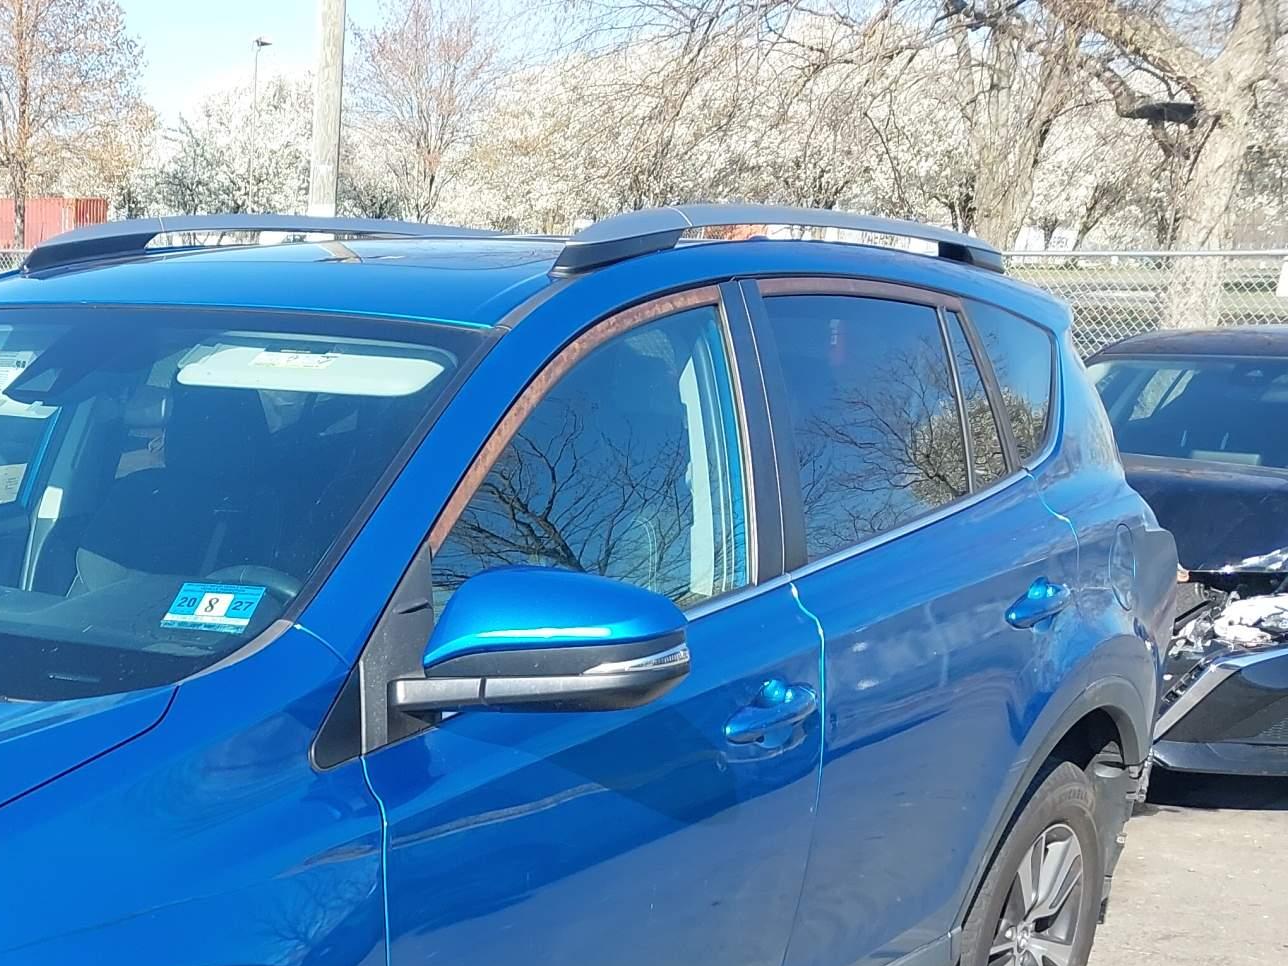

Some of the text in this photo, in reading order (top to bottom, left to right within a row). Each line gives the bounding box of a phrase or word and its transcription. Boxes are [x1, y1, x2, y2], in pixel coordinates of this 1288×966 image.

[177, 597, 254, 613] 20 8 27
